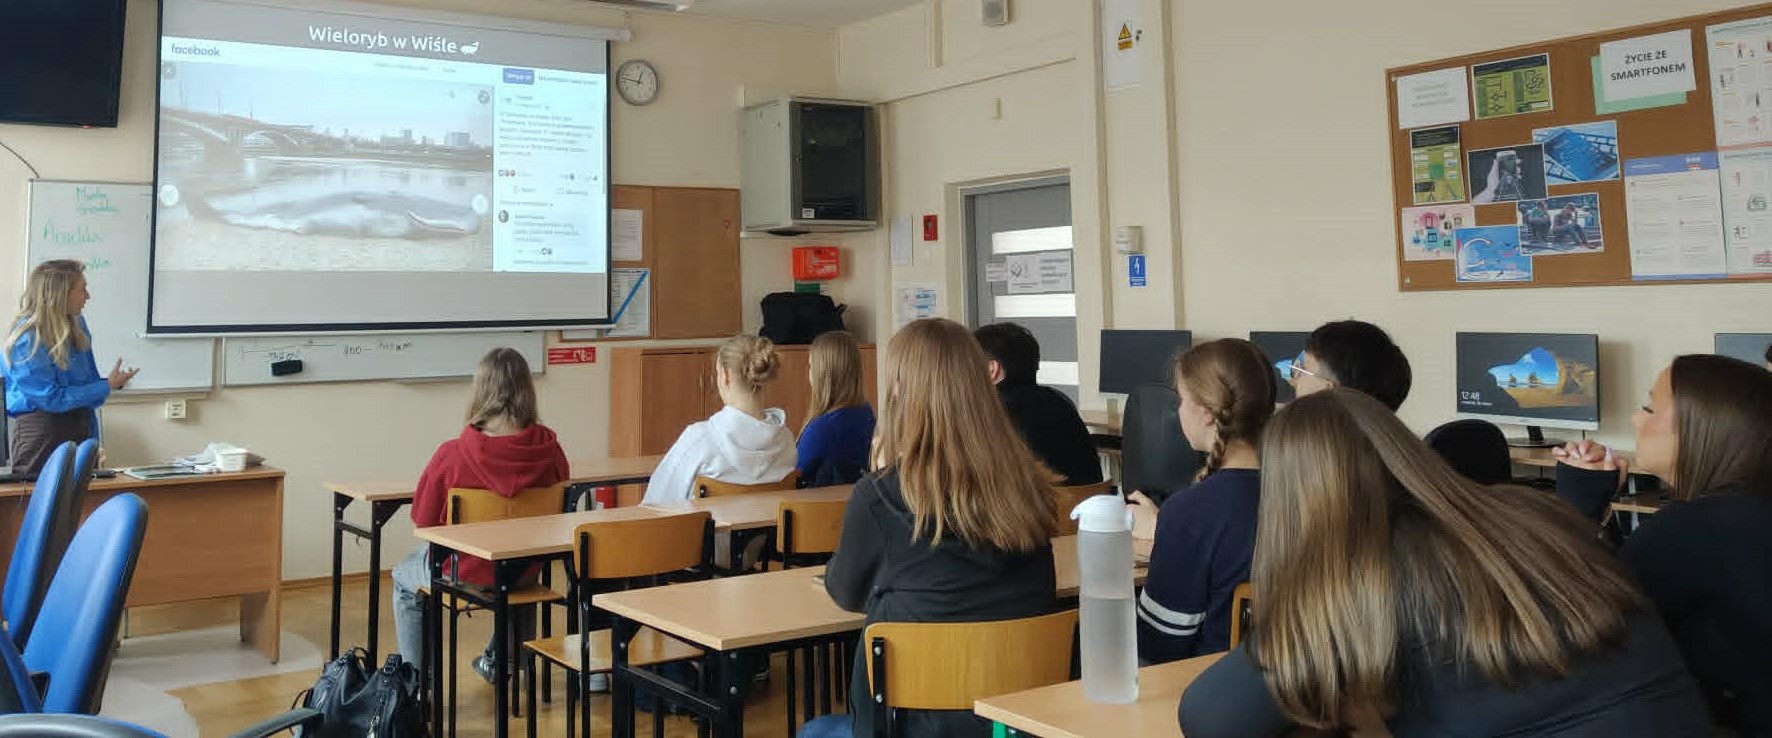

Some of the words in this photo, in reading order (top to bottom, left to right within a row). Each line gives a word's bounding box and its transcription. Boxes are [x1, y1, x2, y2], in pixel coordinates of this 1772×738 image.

[308, 25, 389, 49] Wieloryb
[393, 36, 407, 48] w
[411, 35, 459, 53] Wiśle
[171, 43, 221, 56] facebook
[1611, 62, 1686, 81] SMARTFONEM
[1460, 391, 1480, 401] 12:48
